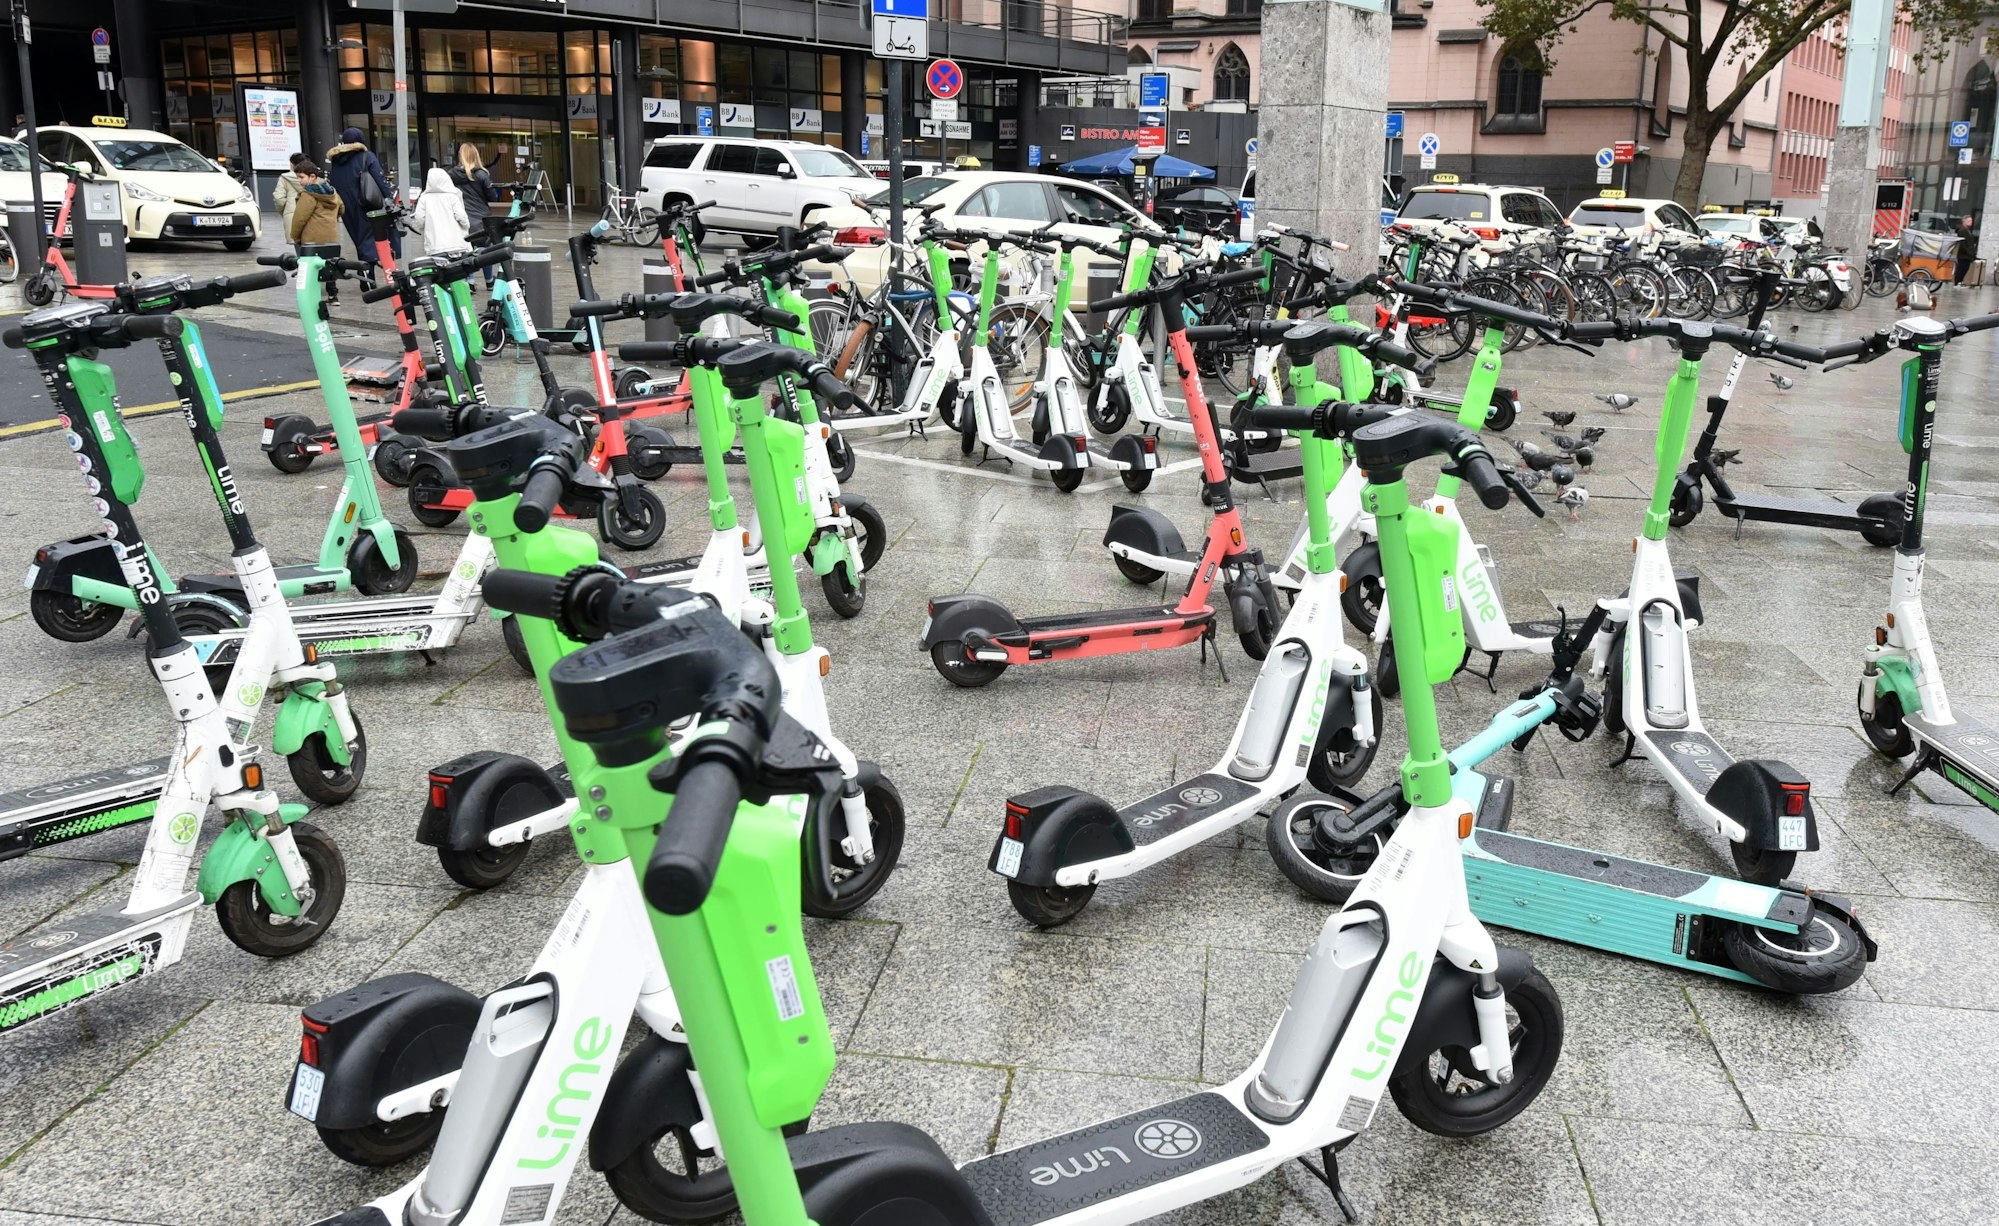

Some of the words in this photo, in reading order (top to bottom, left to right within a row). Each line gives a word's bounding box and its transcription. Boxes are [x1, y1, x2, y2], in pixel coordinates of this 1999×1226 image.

[582, 106, 596, 114] Bank
[644, 103, 654, 111] BB
[662, 110, 679, 118] Bank
[721, 108, 730, 116] BB
[737, 115, 753, 123] Bank
[791, 112, 800, 120] BB
[806, 119, 821, 127] Bank
[869, 123, 883, 131] Bank
[938, 123, 970, 134] MSSNAHME
[1081, 127, 1119, 140] BISTRO
[433, 339, 445, 364] Lime
[473, 383, 489, 406] Lim
[784, 377, 800, 412] Lime
[924, 368, 946, 404] Lime
[1128, 369, 1143, 407] Lime
[180, 398, 197, 428] Lime
[1922, 422, 1933, 449] Lime
[217, 465, 244, 515] Lime
[119, 541, 160, 605] Lime
[1461, 559, 1497, 624] Lime
[1302, 658, 1330, 744] Lime
[1957, 773, 1977, 796] Lime
[1133, 803, 1187, 827] Lime
[1782, 820, 1803, 832] 447
[1004, 841, 1021, 858] 788
[82, 961, 134, 994] Lime
[1350, 950, 1424, 1081] Lime
[299, 1069, 320, 1093] 530
[516, 1016, 612, 1170] Lime
[1029, 1146, 1131, 1186] Lime
